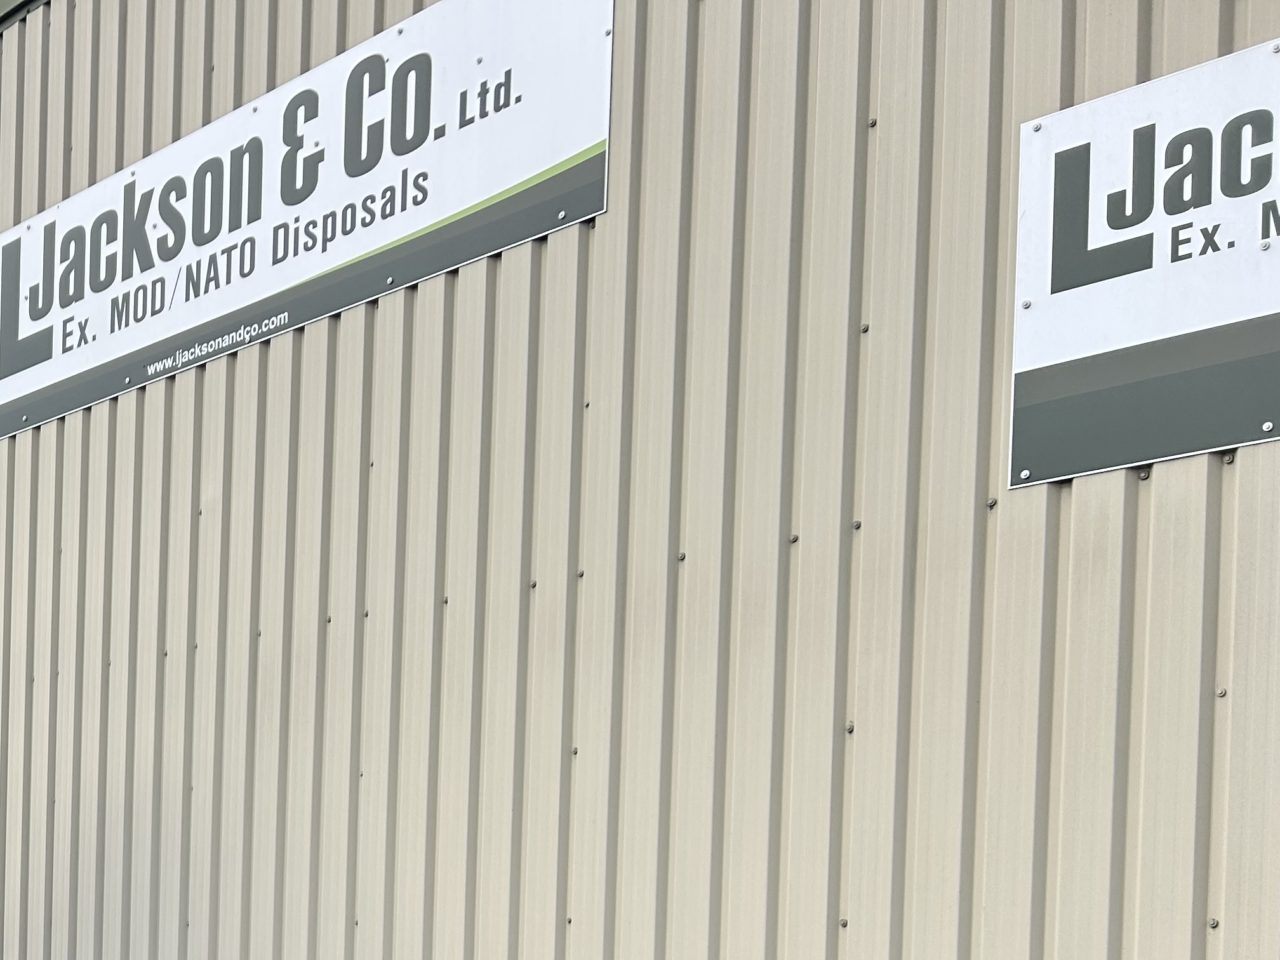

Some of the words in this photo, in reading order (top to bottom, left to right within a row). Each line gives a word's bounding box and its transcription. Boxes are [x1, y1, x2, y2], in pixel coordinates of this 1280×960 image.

[280, 88, 324, 206] &
[344, 52, 446, 178] Co.
[458, 69, 523, 130] Ltd.
[60, 315, 97, 355] Ex.
[110, 236, 256, 335] MOD/NATO
[272, 168, 429, 268] Disposals
[1170, 221, 1235, 263] Ex.
[146, 310, 289, 377] www.ljacksonandco.com
